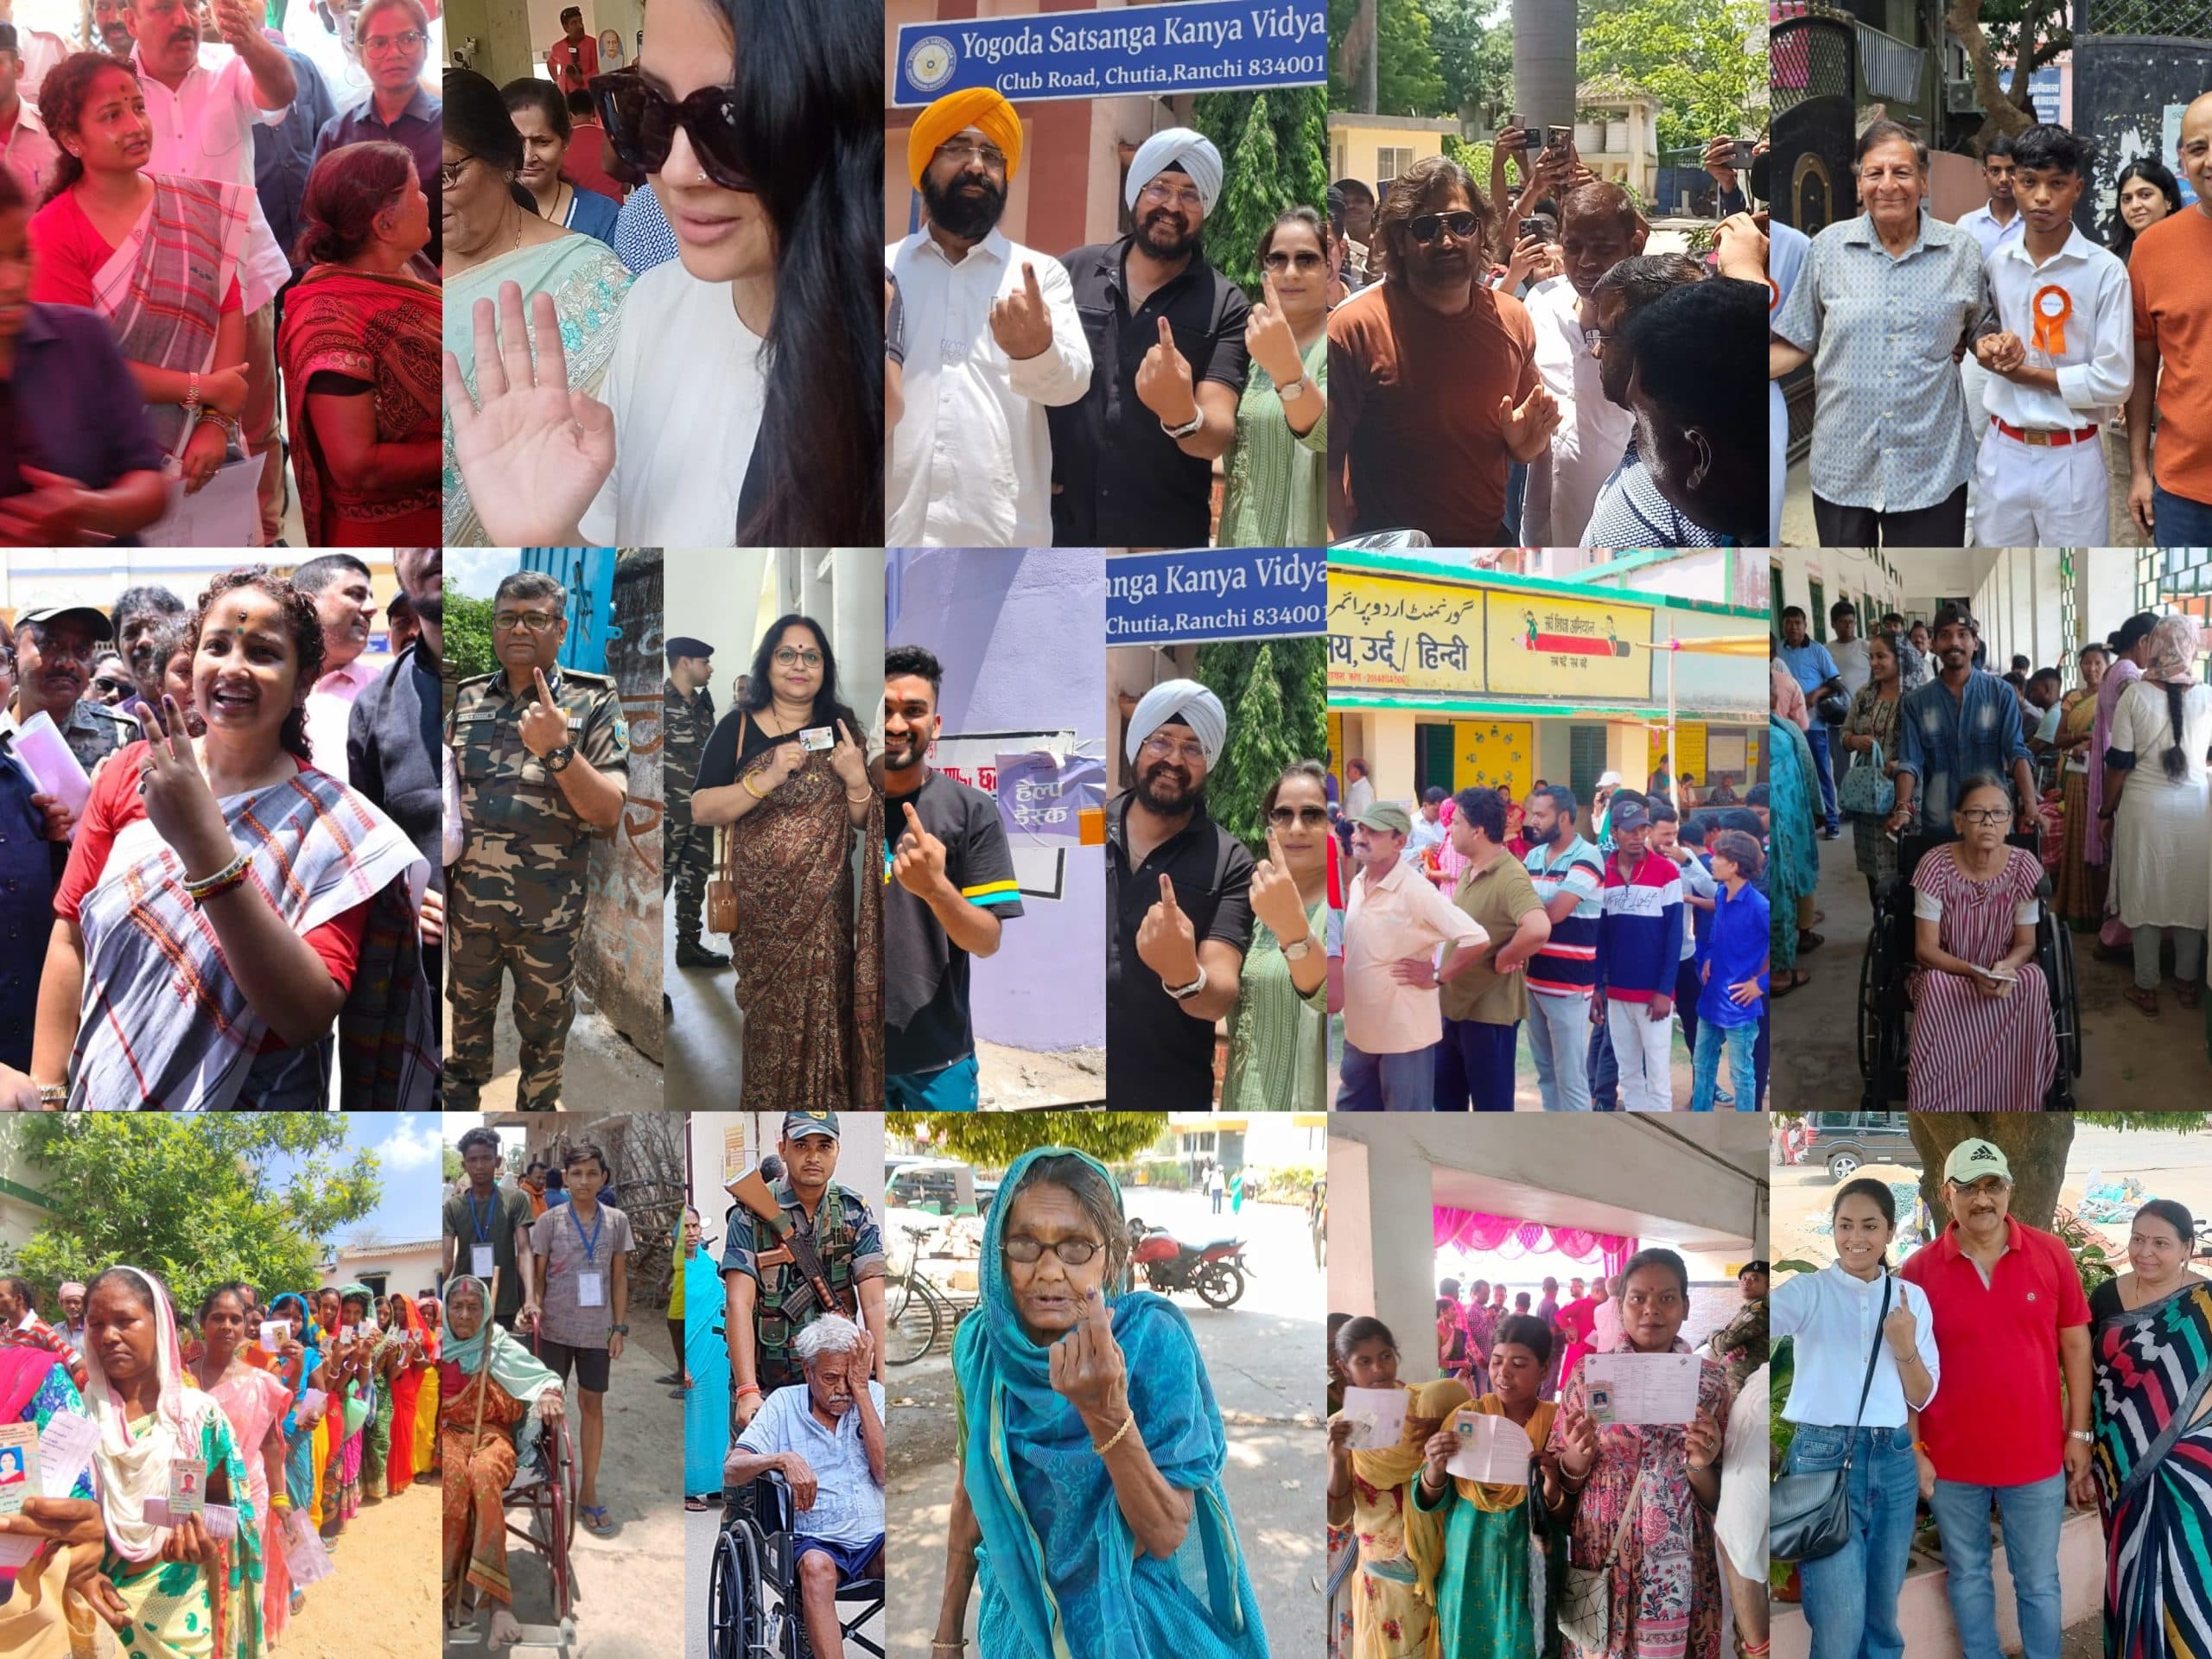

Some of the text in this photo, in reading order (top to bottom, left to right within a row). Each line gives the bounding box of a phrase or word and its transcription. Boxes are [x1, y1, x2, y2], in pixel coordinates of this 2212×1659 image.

[961, 6, 1326, 64] Yogoda Satsanga Kanya Vidya
[996, 71, 1043, 93] (Club
[1047, 67, 1101, 90] Road,
[1248, 54, 1325, 77] 834001
[1165, 564, 1247, 599] Kanya
[1415, 632, 1469, 671] हिन्दी
